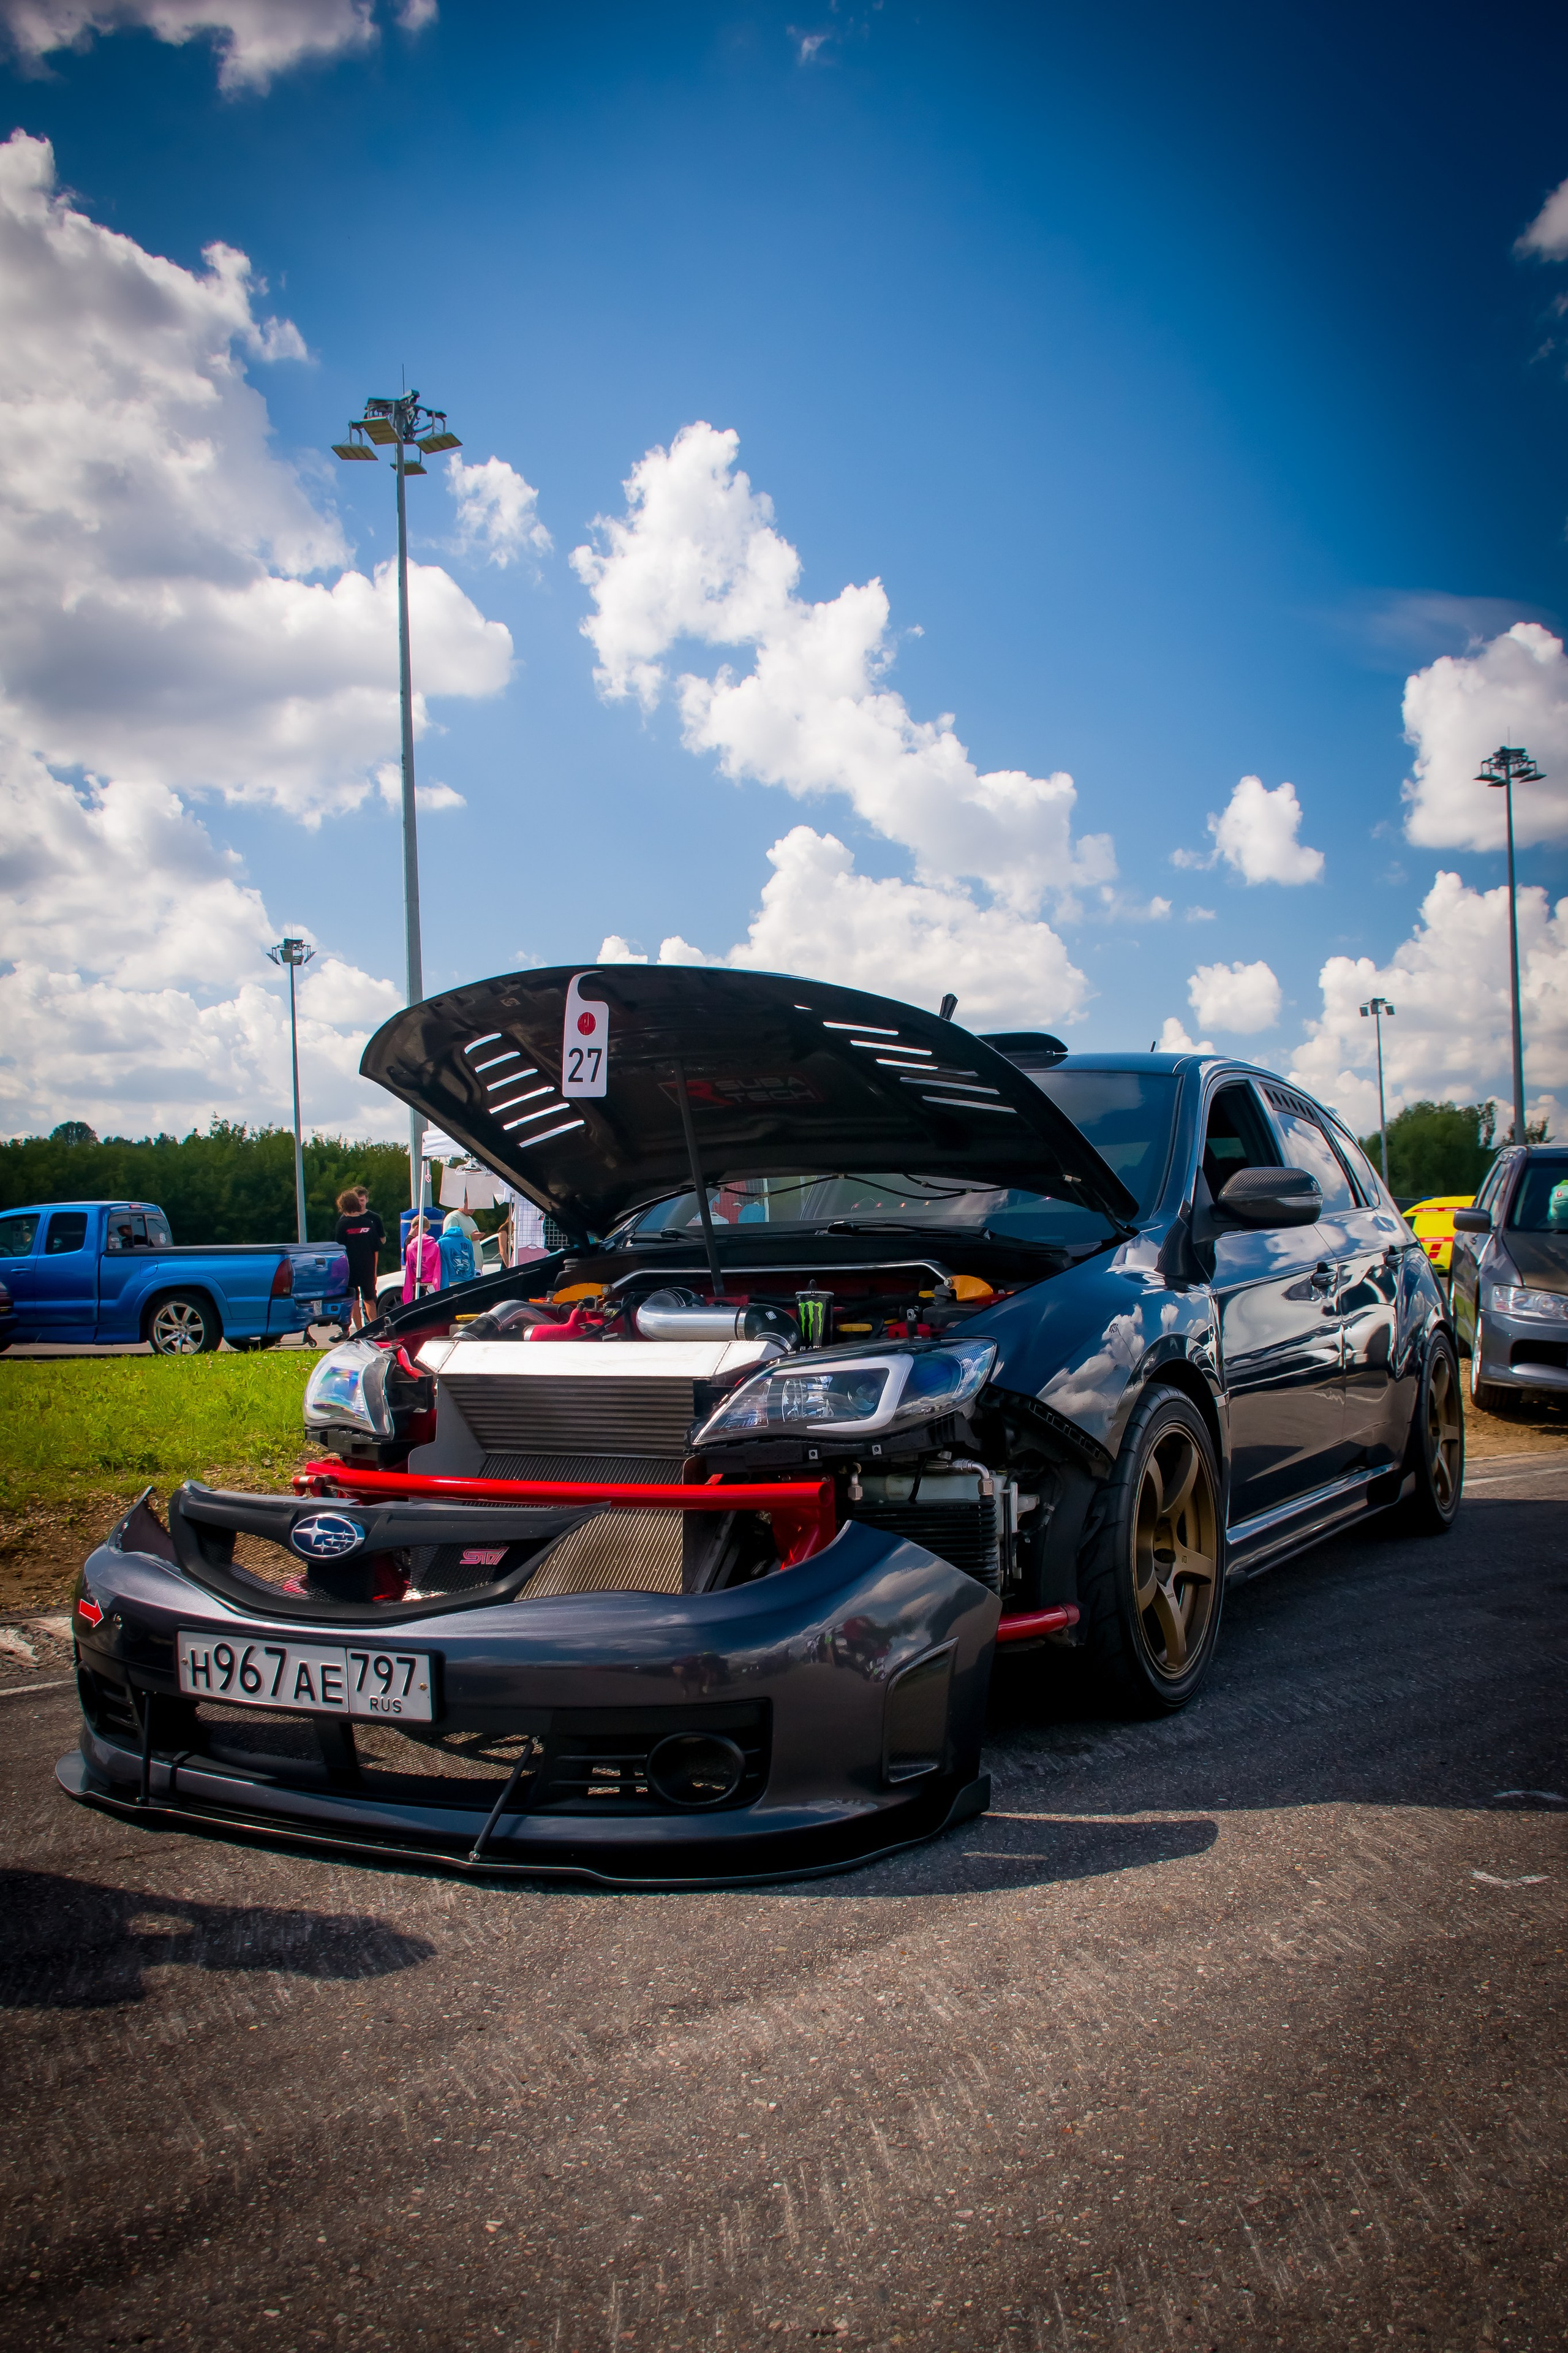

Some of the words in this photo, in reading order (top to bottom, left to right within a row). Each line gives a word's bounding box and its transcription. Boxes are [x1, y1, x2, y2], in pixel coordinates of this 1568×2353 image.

[568, 1048, 603, 1082] 27
[714, 1076, 805, 1092] SUBA
[723, 1088, 816, 1103] TECH
[350, 1652, 417, 1696] 797
[369, 1695, 403, 1713] RUS
